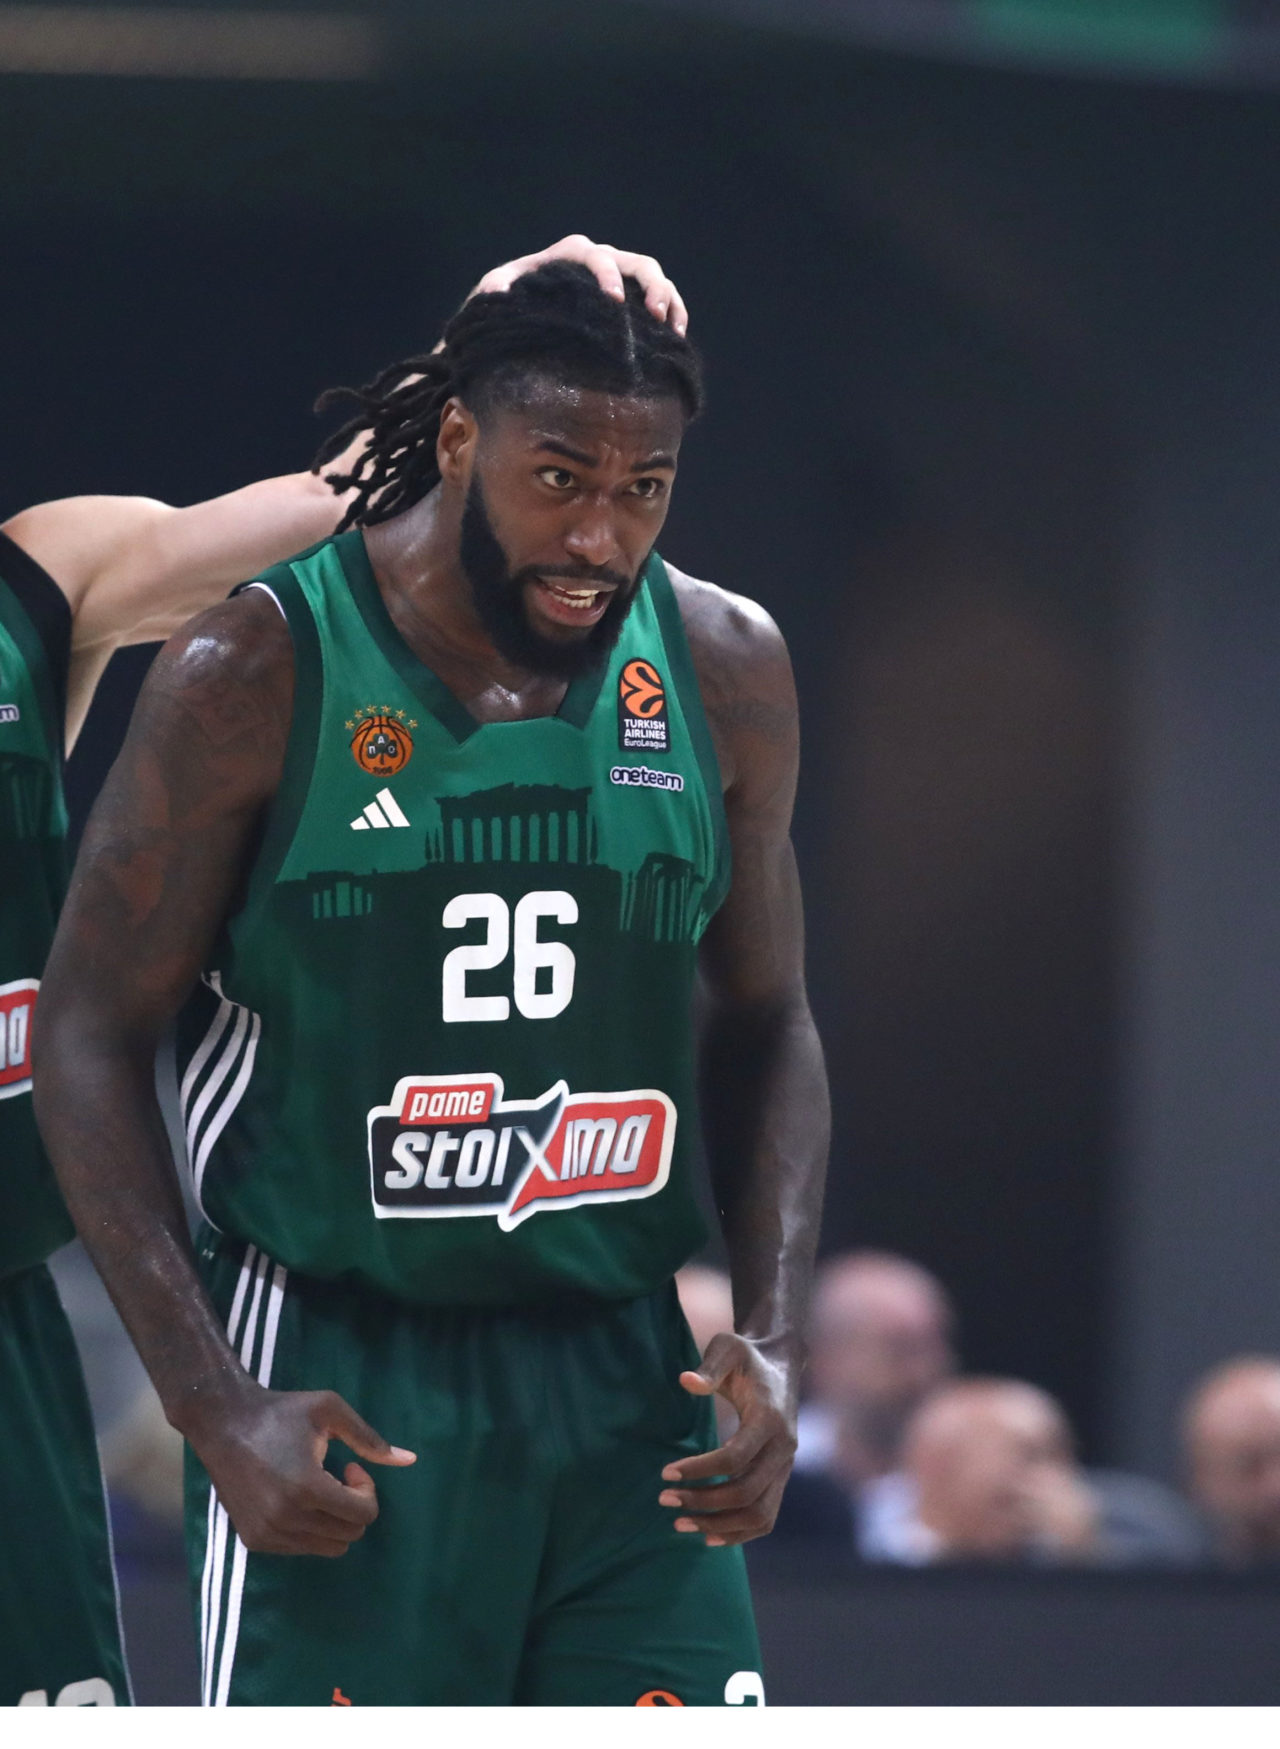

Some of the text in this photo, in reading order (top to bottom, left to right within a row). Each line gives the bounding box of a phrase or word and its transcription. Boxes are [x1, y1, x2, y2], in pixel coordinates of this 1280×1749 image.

[623, 718, 666, 730] TURKISH
[624, 729, 666, 740] AIRLINES
[624, 738, 667, 749] EuroLeague
[611, 767, 682, 790] oneteam
[442, 890, 579, 1023] 26
[408, 1088, 487, 1122] pame
